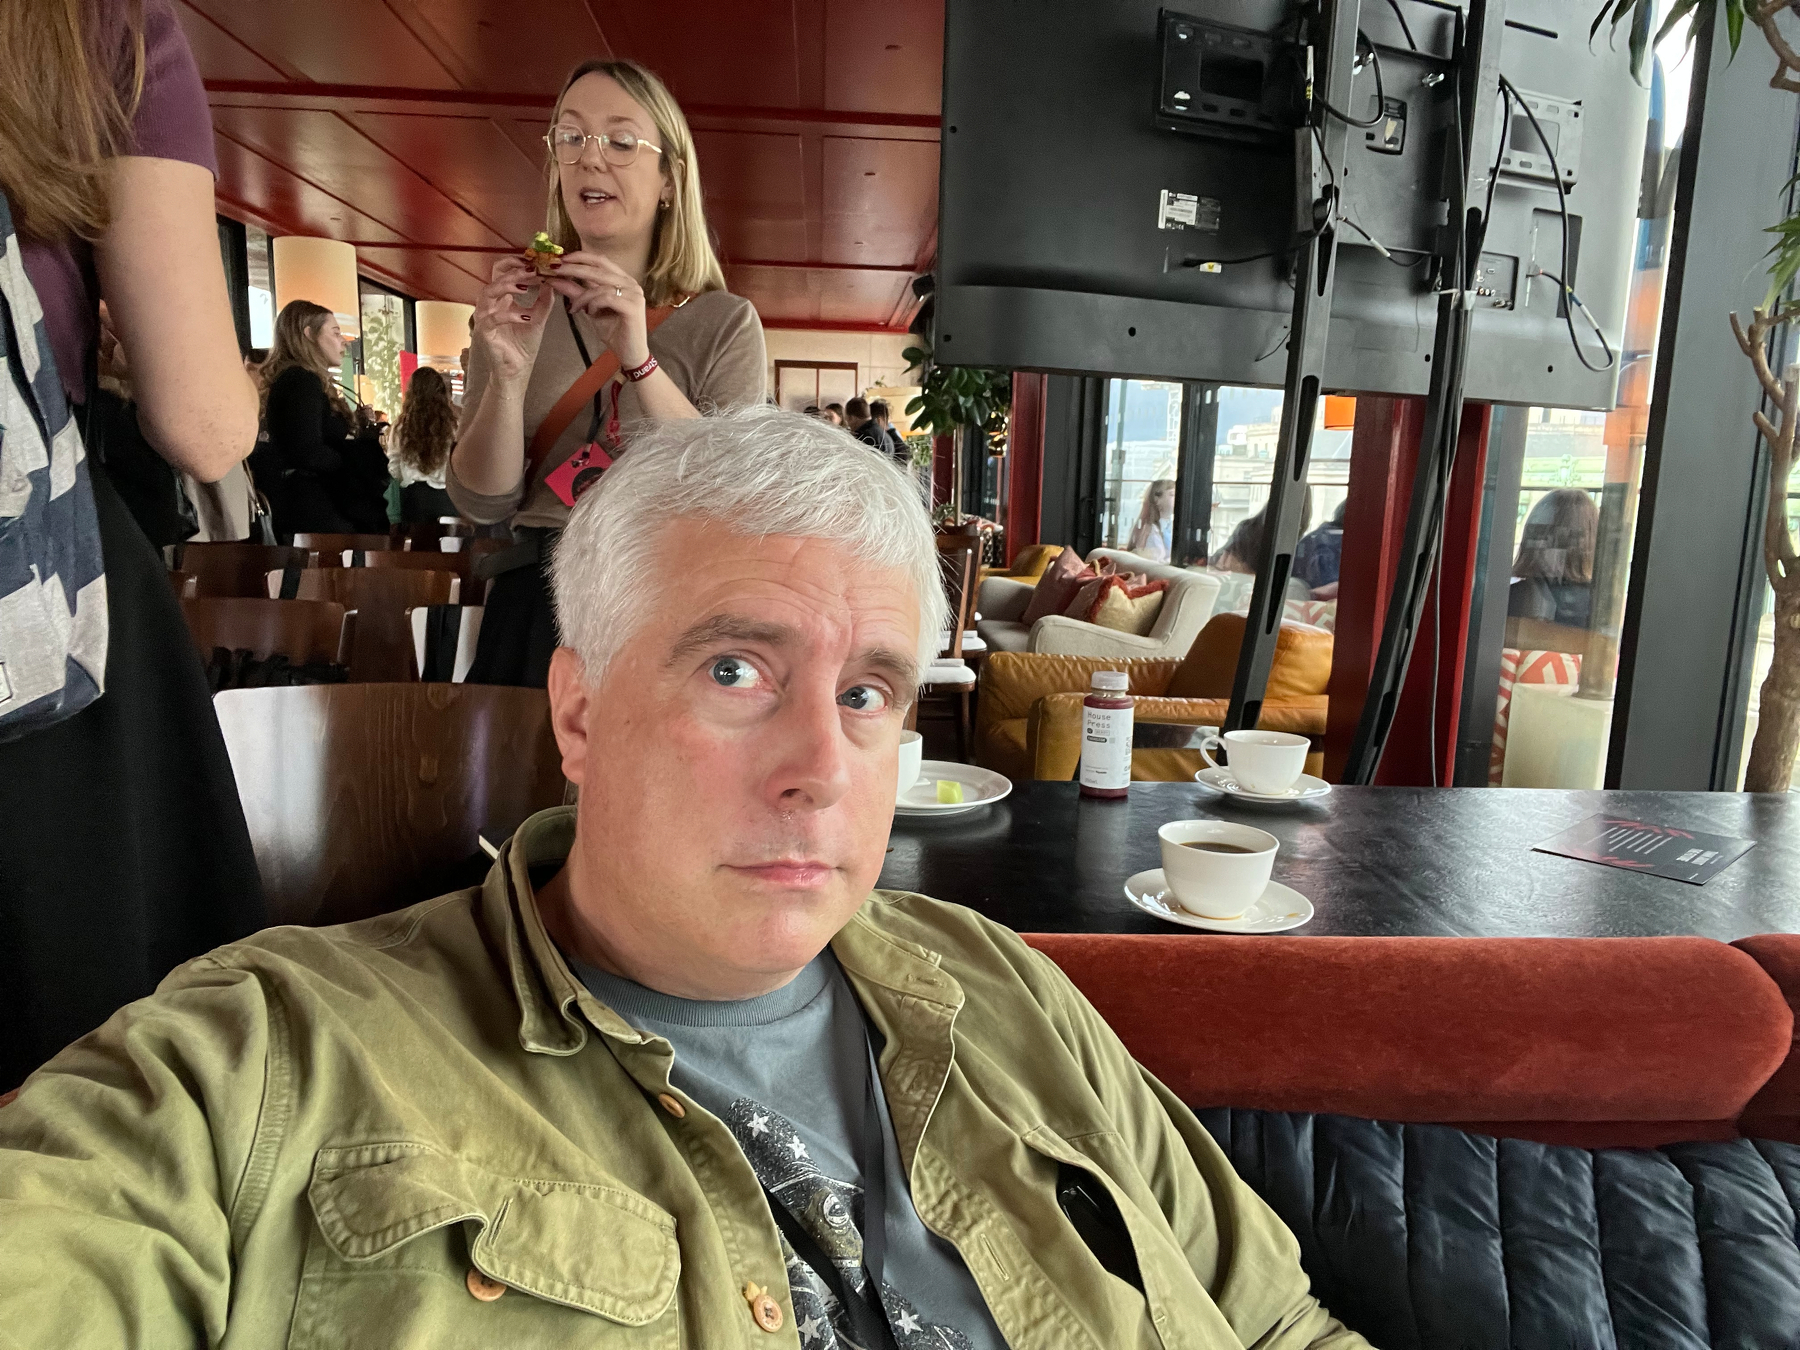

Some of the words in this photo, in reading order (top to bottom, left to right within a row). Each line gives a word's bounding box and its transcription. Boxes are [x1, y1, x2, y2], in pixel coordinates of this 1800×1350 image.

[633, 357, 658, 379] Strand
[1087, 711, 1111, 721] House
[1087, 720, 1111, 729] Press
